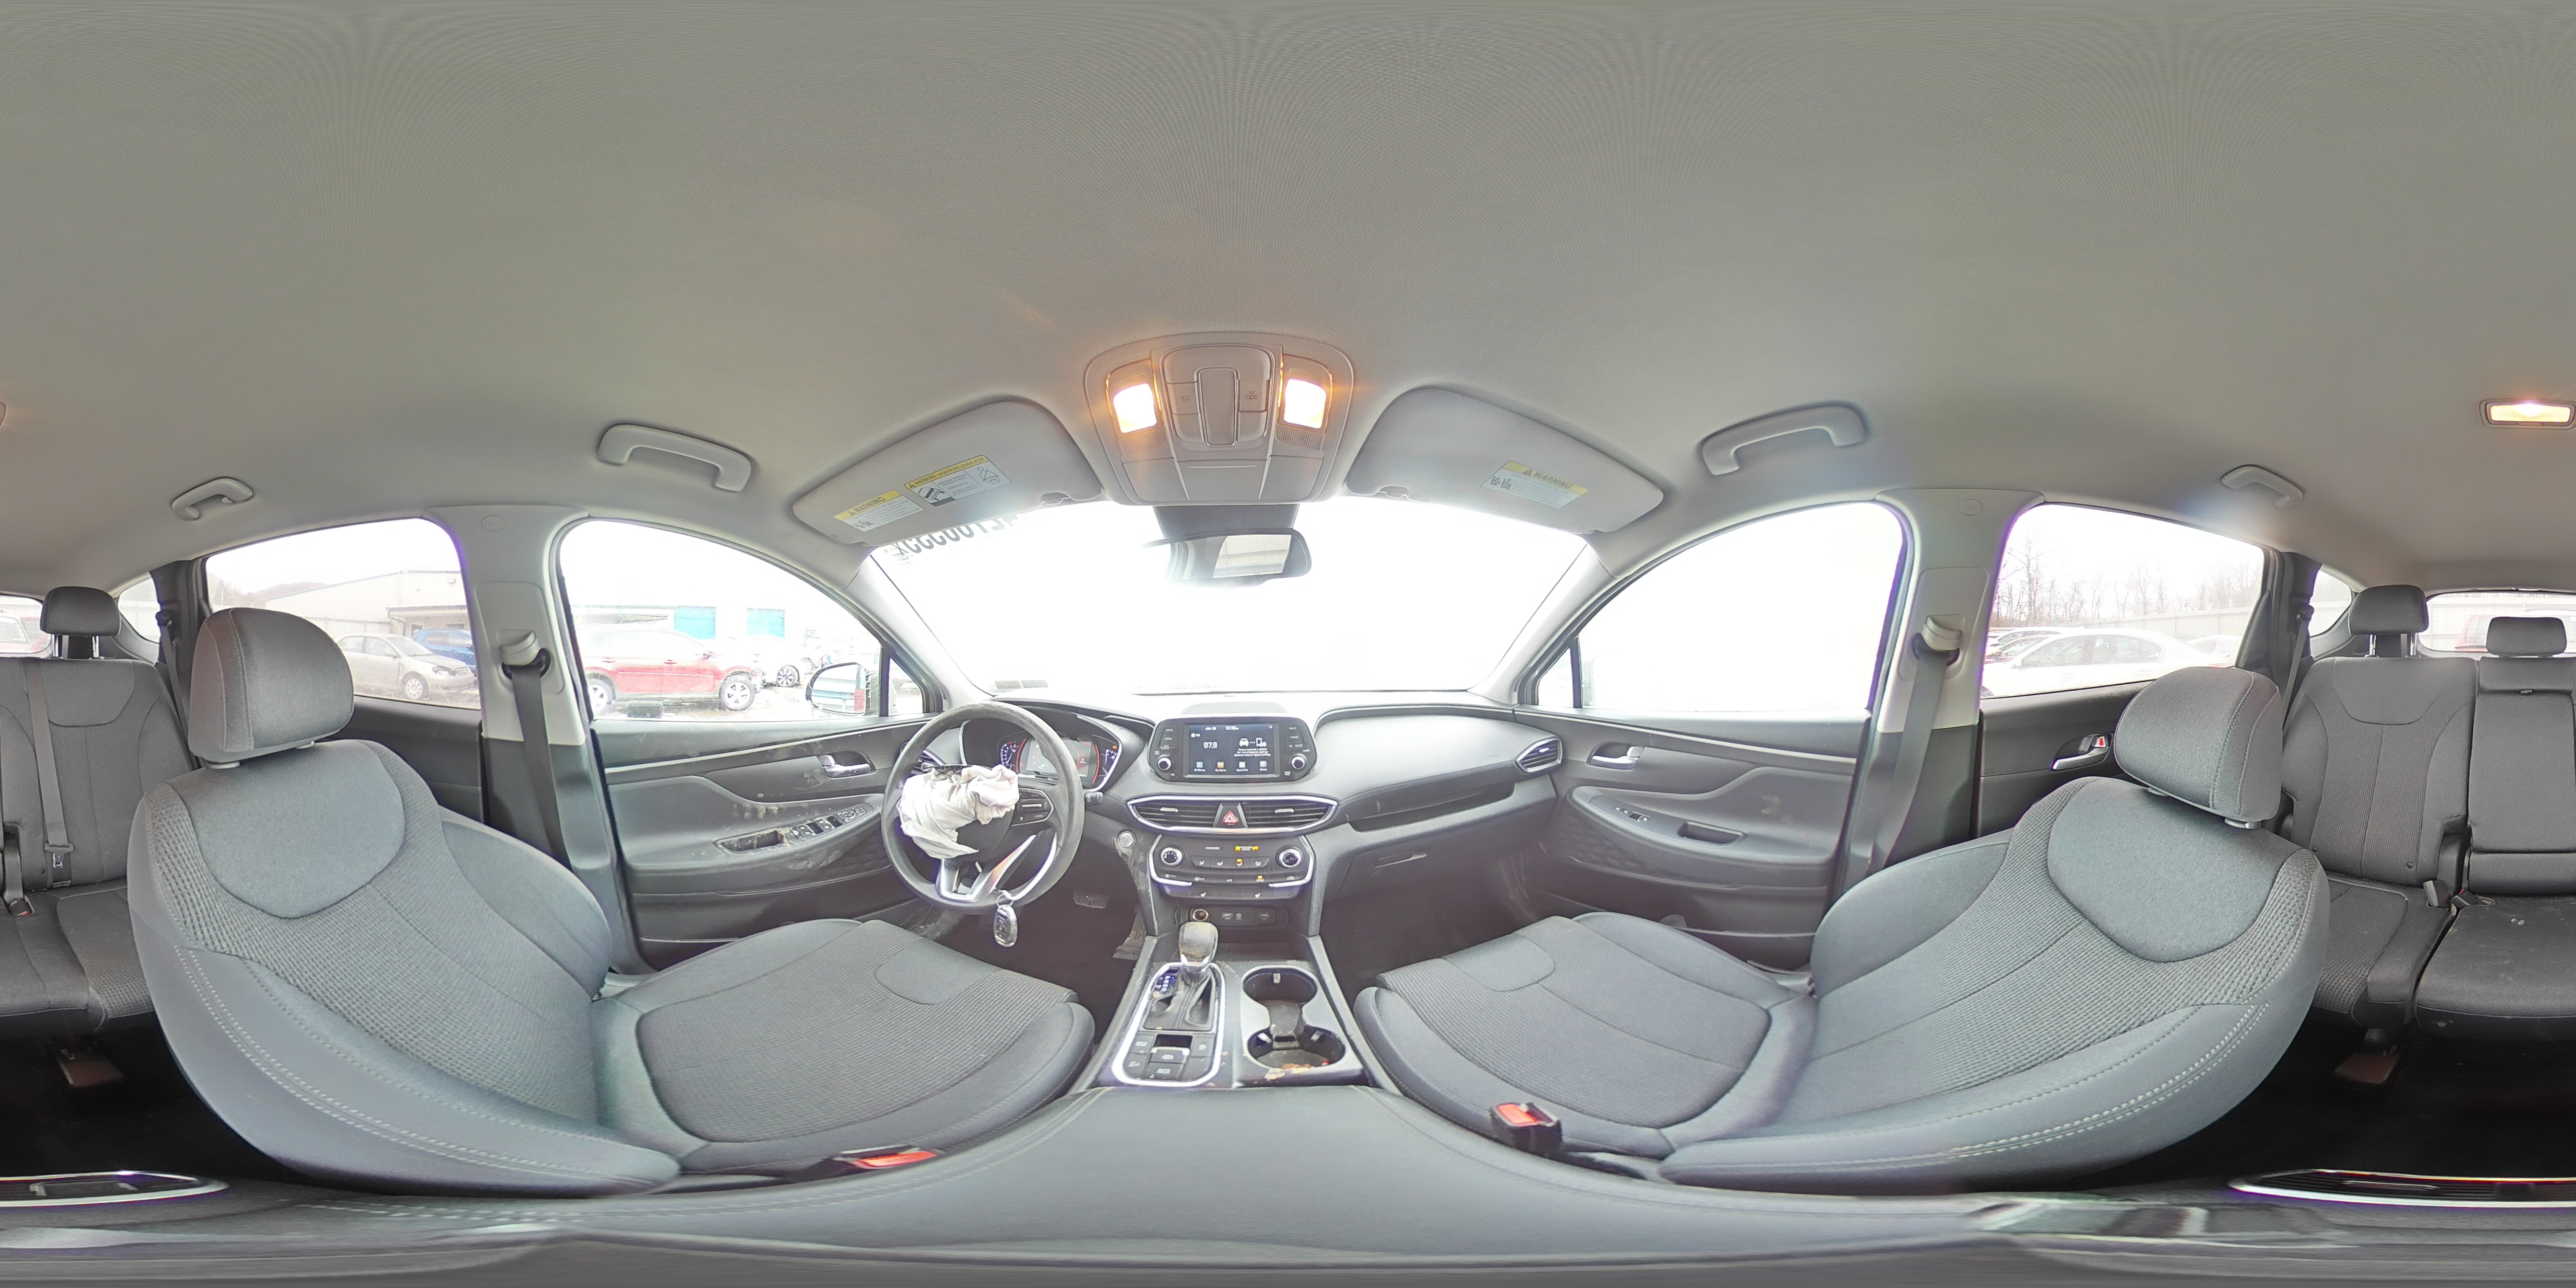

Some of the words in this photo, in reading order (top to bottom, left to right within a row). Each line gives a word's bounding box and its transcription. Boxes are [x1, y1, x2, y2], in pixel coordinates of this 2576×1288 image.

[953, 461, 974, 471] ROLLOVER
[1533, 471, 1574, 489] WARNING
[852, 496, 886, 513] WARNING
